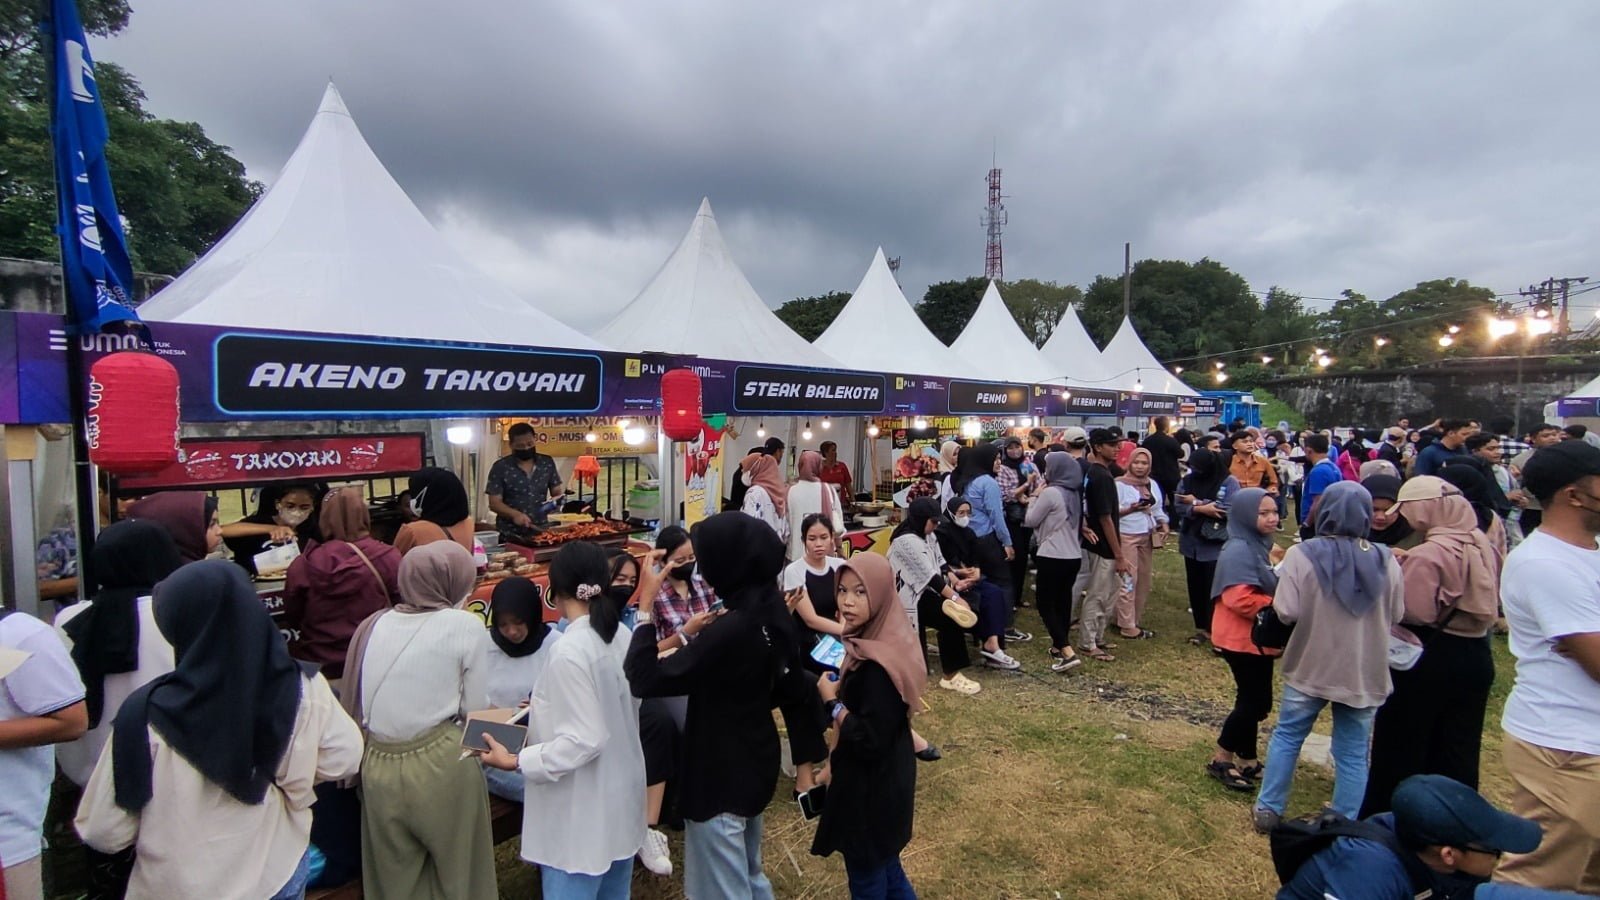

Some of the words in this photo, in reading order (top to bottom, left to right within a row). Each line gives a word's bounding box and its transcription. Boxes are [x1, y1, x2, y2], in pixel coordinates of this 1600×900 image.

[642, 364, 665, 374] PLN
[248, 362, 406, 389] AKENO
[424, 368, 585, 392] TAKOYAKI
[904, 380, 915, 388] PLN
[743, 381, 802, 397] STEAK
[805, 384, 879, 400] BALEKOTA
[976, 392, 1008, 404] PENMO
[1097, 399, 1112, 407] FOOD
[230, 451, 341, 470] TAKOYAKI
